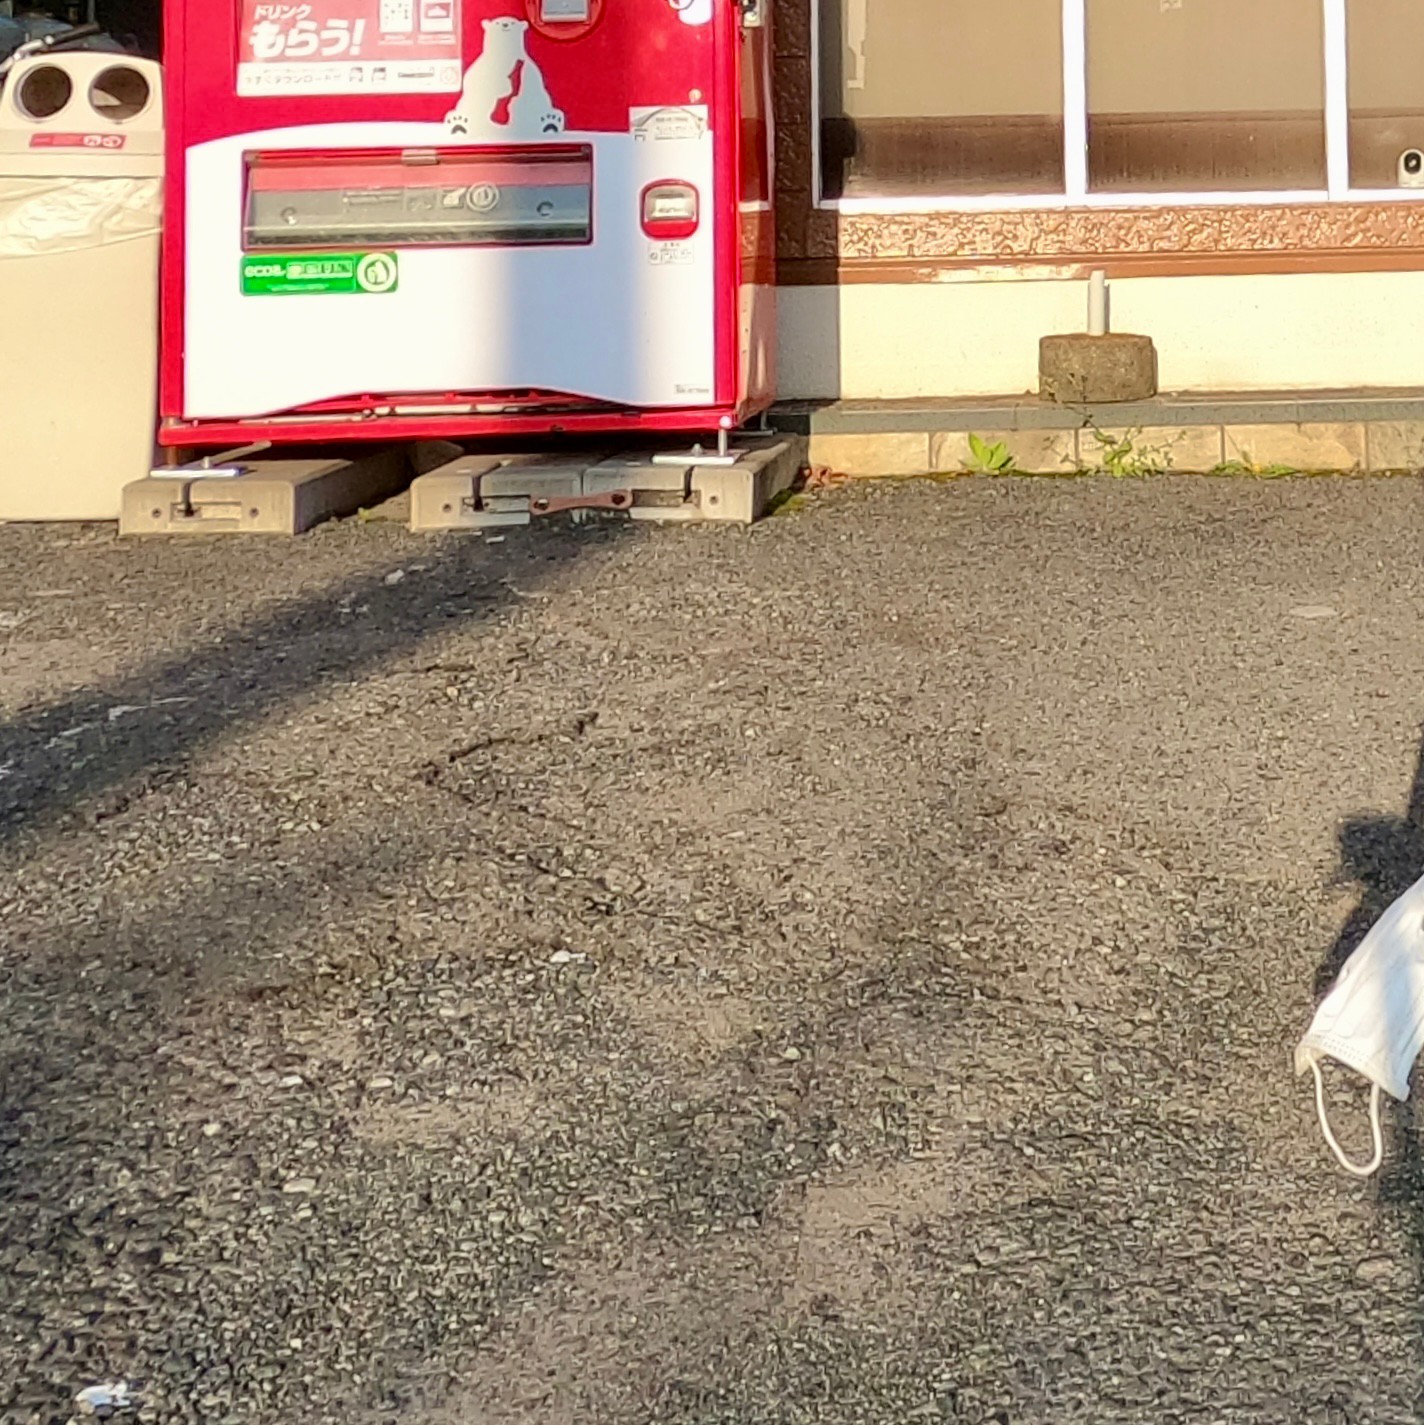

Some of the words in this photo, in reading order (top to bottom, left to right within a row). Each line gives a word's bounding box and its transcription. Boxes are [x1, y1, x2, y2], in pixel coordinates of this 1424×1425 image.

[253, 3, 313, 20] ドリンク
[248, 17, 367, 59] もらう!
